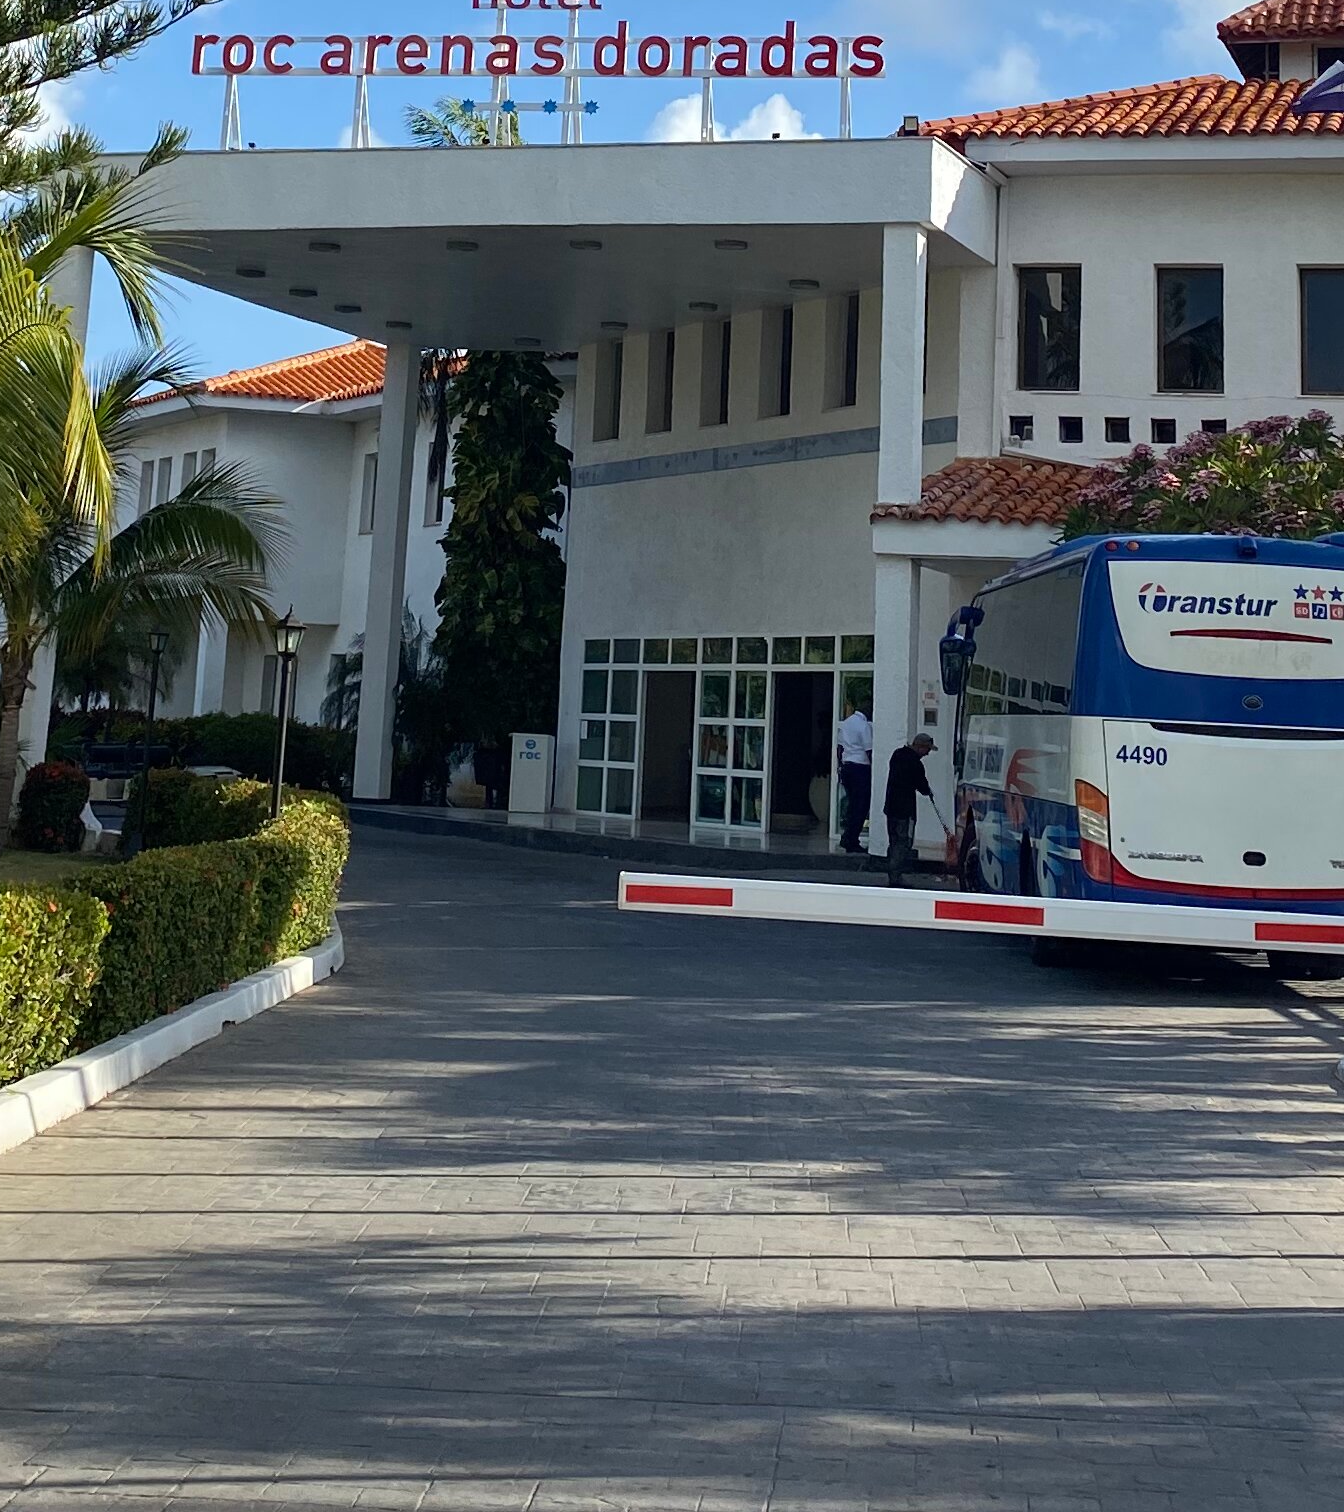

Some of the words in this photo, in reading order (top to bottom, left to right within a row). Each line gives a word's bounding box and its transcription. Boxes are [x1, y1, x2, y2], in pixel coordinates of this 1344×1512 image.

[192, 34, 296, 76] roc
[320, 34, 565, 76] arenas
[593, 20, 885, 78] doradas
[519, 751, 541, 760] roc
[1116, 744, 1168, 766] 4490
